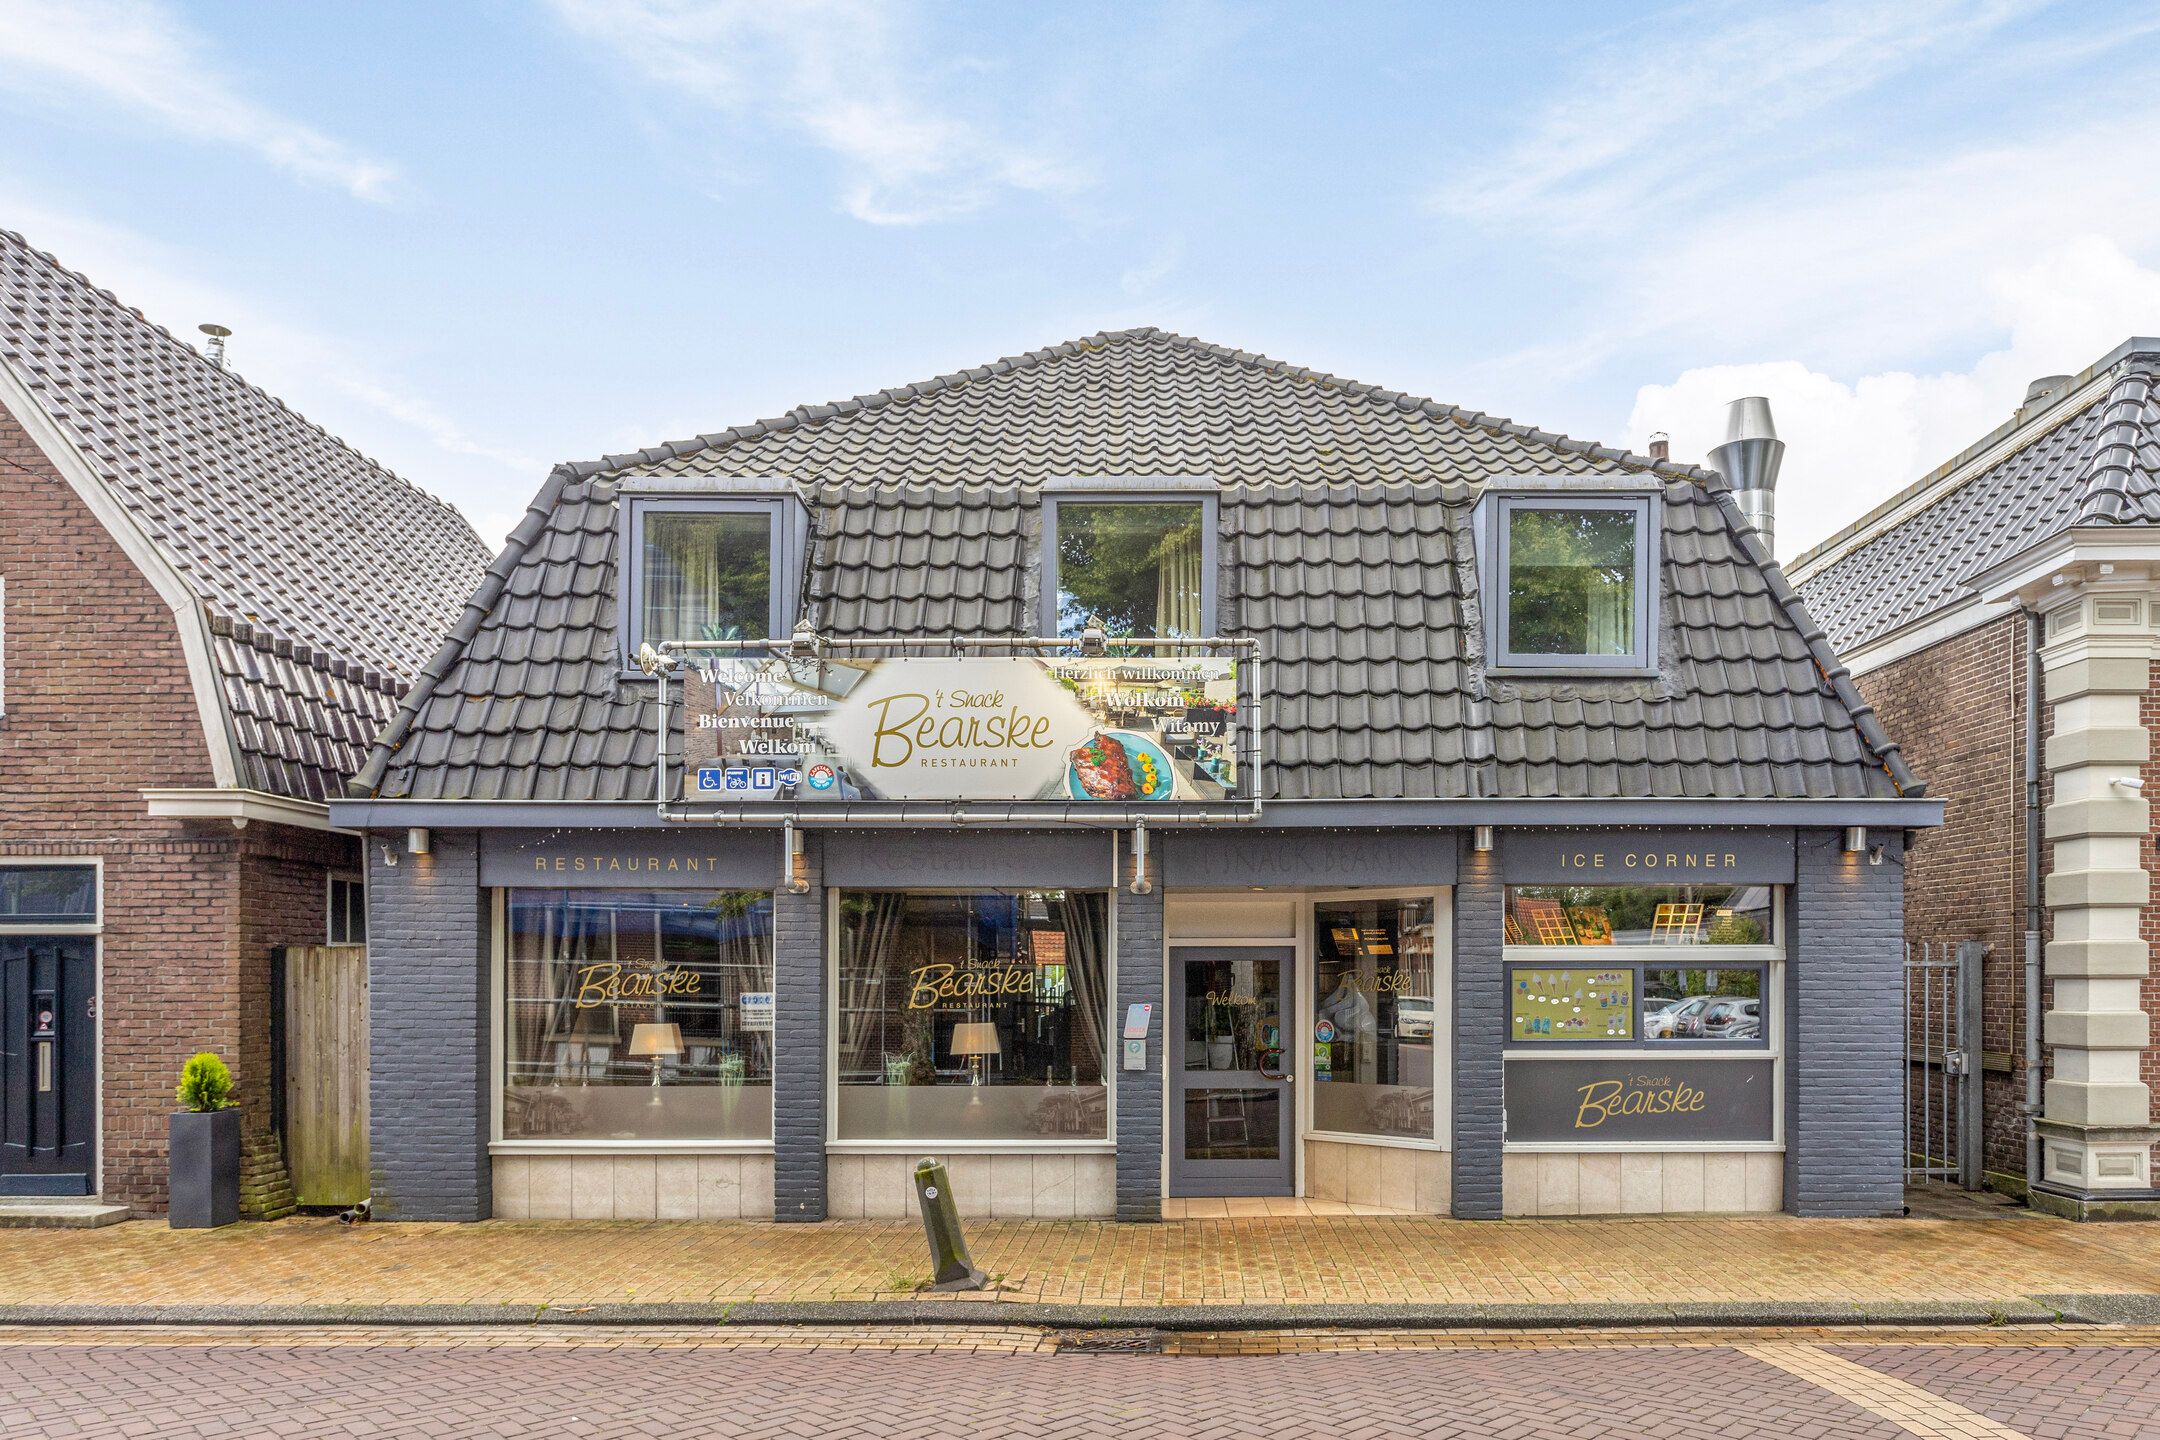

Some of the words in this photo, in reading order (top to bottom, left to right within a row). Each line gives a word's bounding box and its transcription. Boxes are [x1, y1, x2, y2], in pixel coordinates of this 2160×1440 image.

[699, 668, 784, 683] Welcome
[1054, 666, 1116, 680] Herzlich
[1123, 666, 1219, 680] willkommen
[724, 691, 828, 706] Velkommen
[950, 689, 1004, 708] Snack
[1105, 692, 1185, 707] Wolkom
[698, 714, 795, 729] Bienvenue
[1151, 718, 1221, 736] Witamy
[867, 693, 1054, 768] Bearske
[738, 739, 816, 754] Welkom
[921, 758, 1018, 767] RESTAURANT
[535, 857, 717, 871] RESTAURANT
[1561, 854, 1605, 867] ICE
[1625, 853, 1736, 867] CORNER
[968, 958, 1001, 969] Snack
[575, 963, 701, 1009] Bearske
[908, 964, 1033, 1009] Bearske
[1336, 968, 1412, 1000] Barske
[1206, 990, 1257, 1006] Welkom
[1636, 1075, 1671, 1087] Snack
[1575, 1080, 1705, 1128] Bearske
